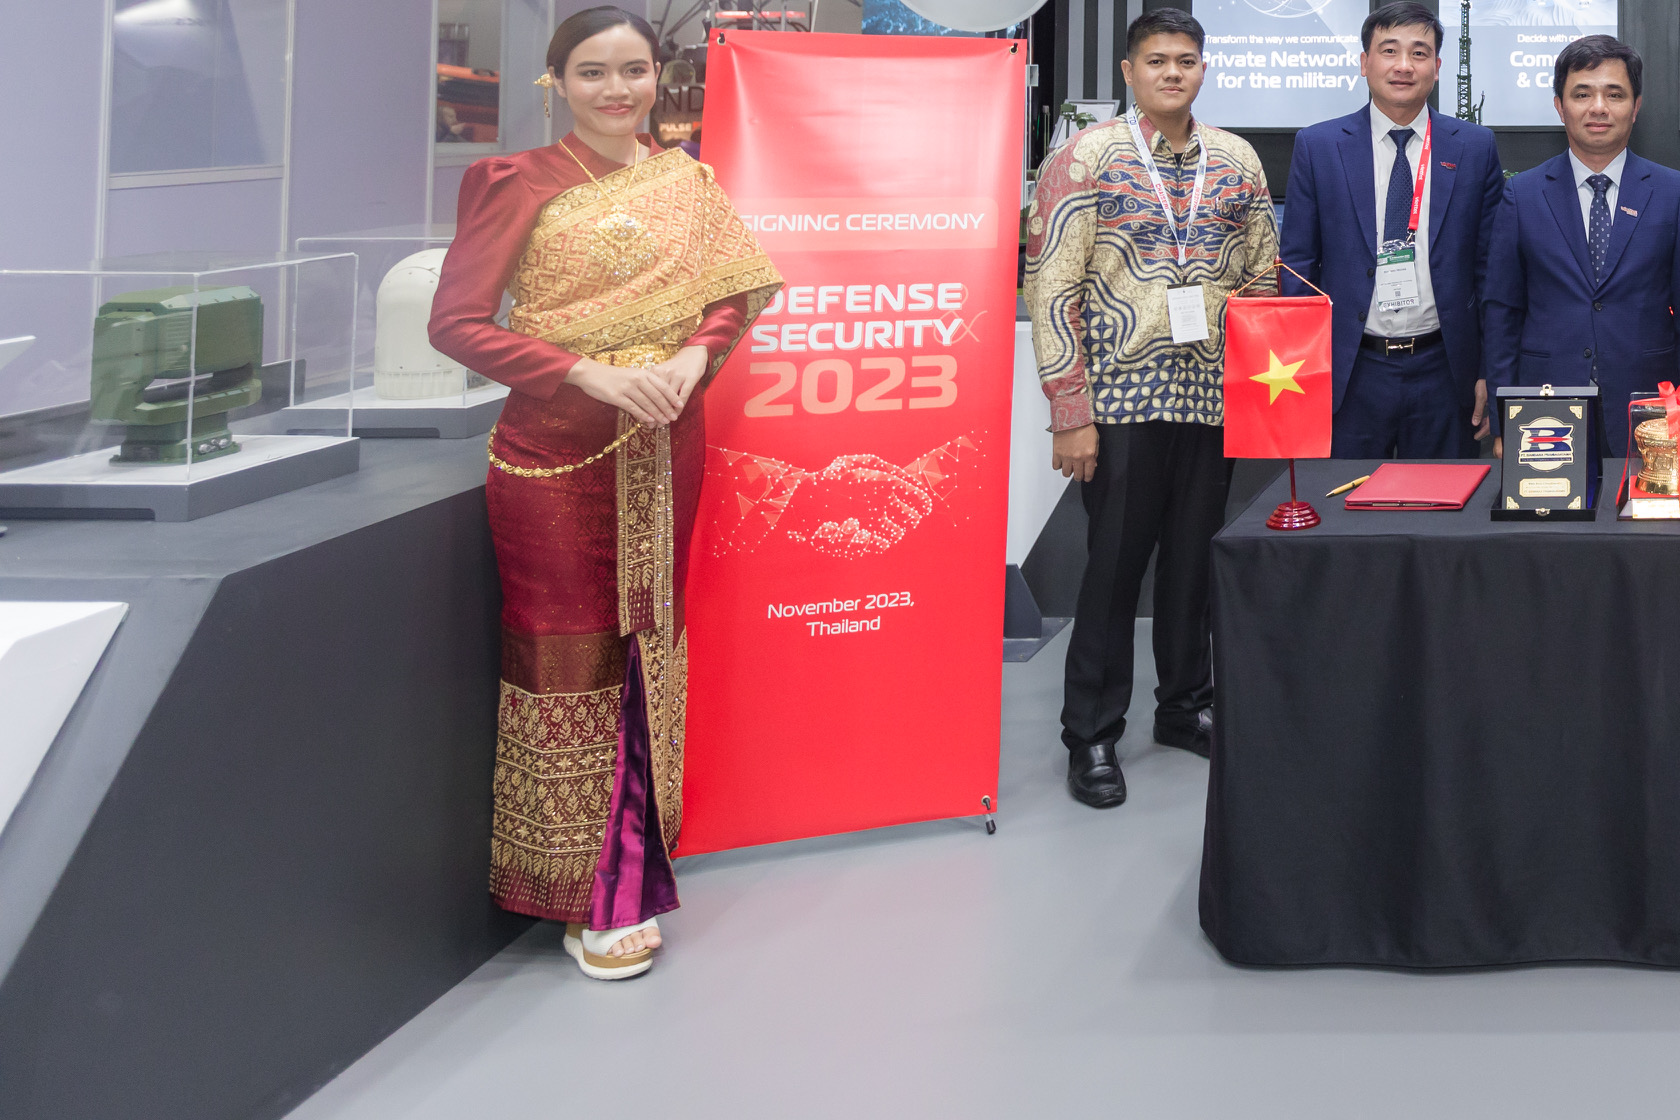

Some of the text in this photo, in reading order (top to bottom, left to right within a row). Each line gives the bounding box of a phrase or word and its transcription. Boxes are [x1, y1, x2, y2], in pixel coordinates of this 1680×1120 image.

[1205, 34, 1359, 45] Transform the way we communicate
[1202, 50, 1358, 68] Private Network
[1216, 71, 1359, 91] for the military
[1516, 72, 1531, 88] &
[741, 212, 985, 231] SIGNING CEREMONY
[751, 318, 965, 354] SECURITY
[744, 354, 959, 418] 2023
[767, 591, 915, 620] November 2023,
[806, 615, 881, 637] Thailand
